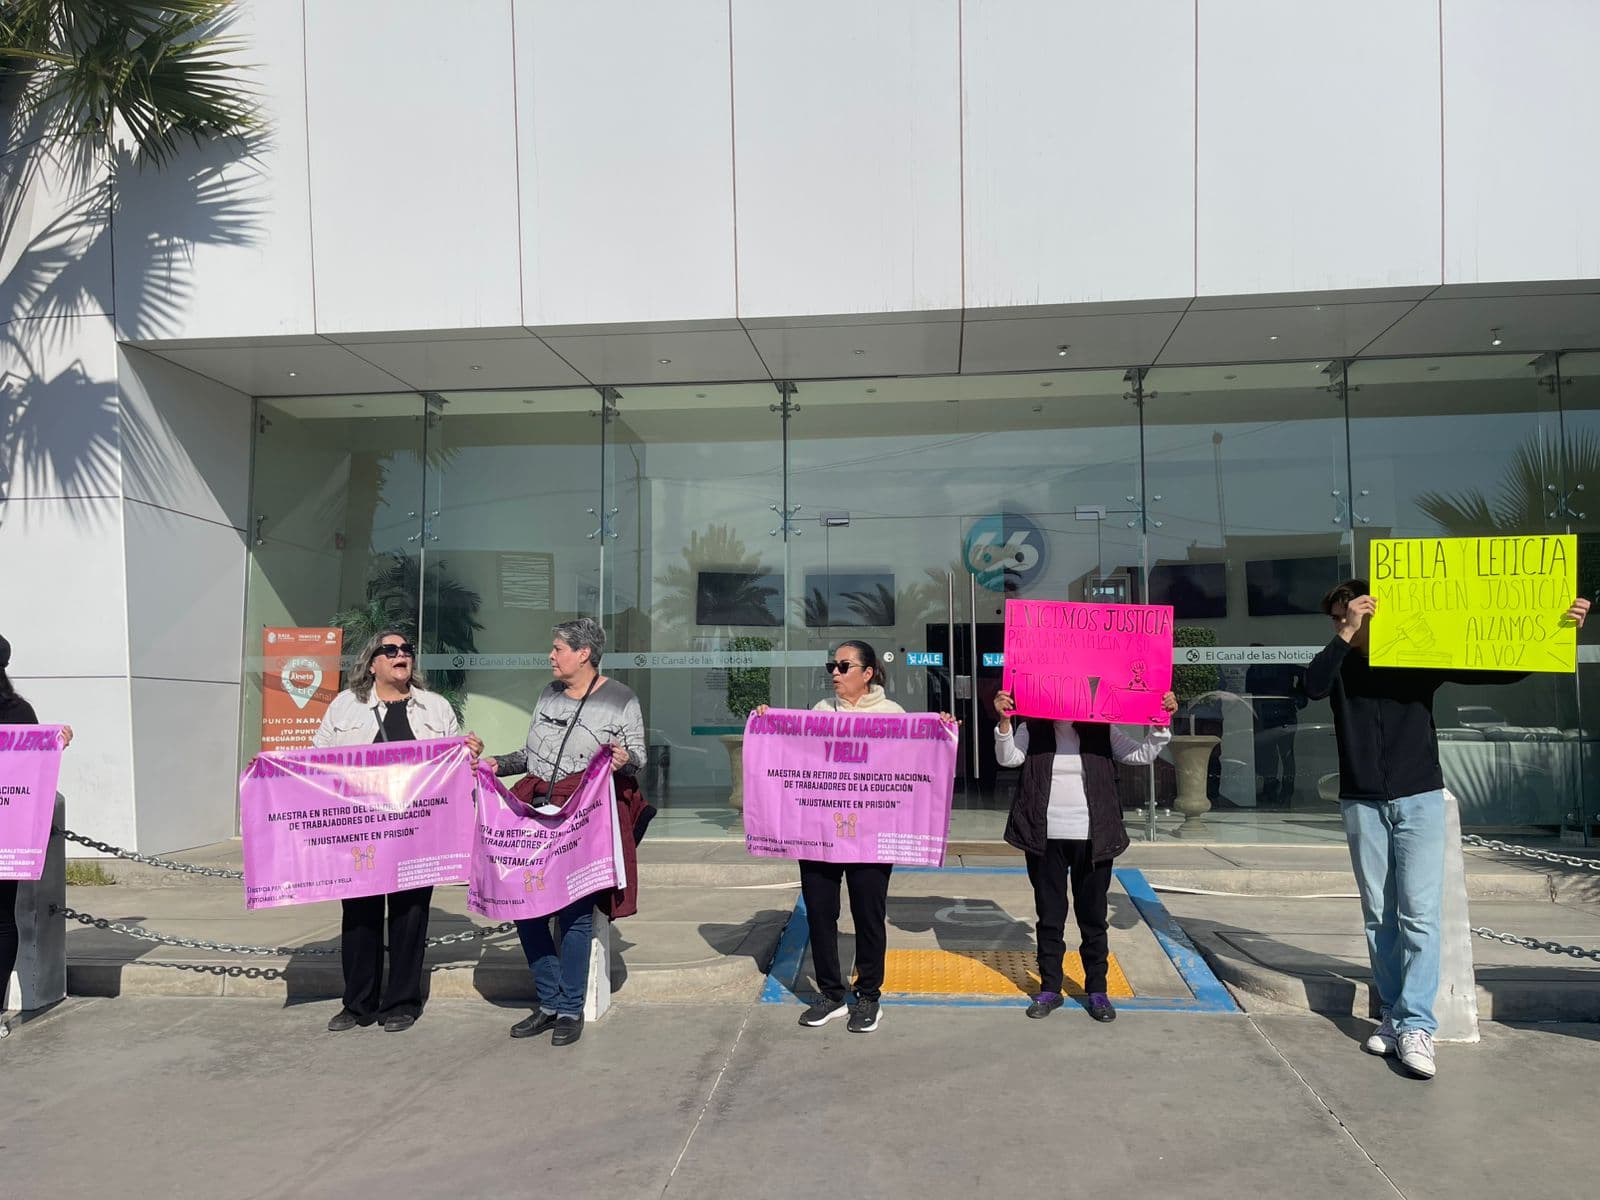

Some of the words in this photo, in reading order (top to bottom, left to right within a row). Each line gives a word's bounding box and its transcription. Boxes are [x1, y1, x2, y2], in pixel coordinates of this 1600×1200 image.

[1376, 540, 1447, 579] BELLA
[1477, 537, 1567, 577] LETICIA
[1377, 580, 1469, 614] MERECEN
[1480, 578, 1572, 611] JUSTICIA
[1104, 609, 1172, 636] JUSTICIA
[661, 655, 686, 665] Canal
[688, 655, 699, 665] de
[919, 653, 940, 664] JALE
[994, 654, 1004, 664] JA
[1206, 652, 1214, 660] El
[1217, 651, 1244, 661] Canal
[1247, 650, 1259, 660] de
[1262, 650, 1275, 660] las
[1492, 644, 1527, 667] VOZ
[804, 716, 834, 738] PARA
[837, 717, 851, 738] LA
[854, 718, 908, 739] MAESTRA
[824, 741, 831, 762] Y
[833, 742, 869, 763] BELLA
[767, 769, 800, 778] MAESTRA
[803, 770, 811, 778] EN
[813, 771, 837, 780] RETIRO
[839, 772, 851, 780] DEL
[853, 773, 892, 782] SINDICATO
[894, 774, 931, 783] NACIONAL
[784, 781, 793, 789] DE
[795, 781, 846, 791] TRABAJADORES
[850, 783, 858, 791] DE
[860, 784, 868, 792] LA
[871, 783, 913, 792] EDUCACIÓN
[268, 811, 307, 822] MAESTRA
[309, 810, 320, 819] EN
[322, 807, 351, 818] RETIRO
[353, 805, 367, 814] DEL
[412, 796, 448, 808] NACIONAL
[853, 800, 863, 808] EN
[289, 821, 300, 831] DE
[302, 818, 363, 830] TRABAJADORES
[365, 814, 374, 824] DE
[377, 813, 386, 822] LA
[388, 808, 431, 821] EDUCACIÓN
[371, 831, 382, 841] EN
[494, 829, 505, 838] EN
[534, 829, 548, 839] DEL
